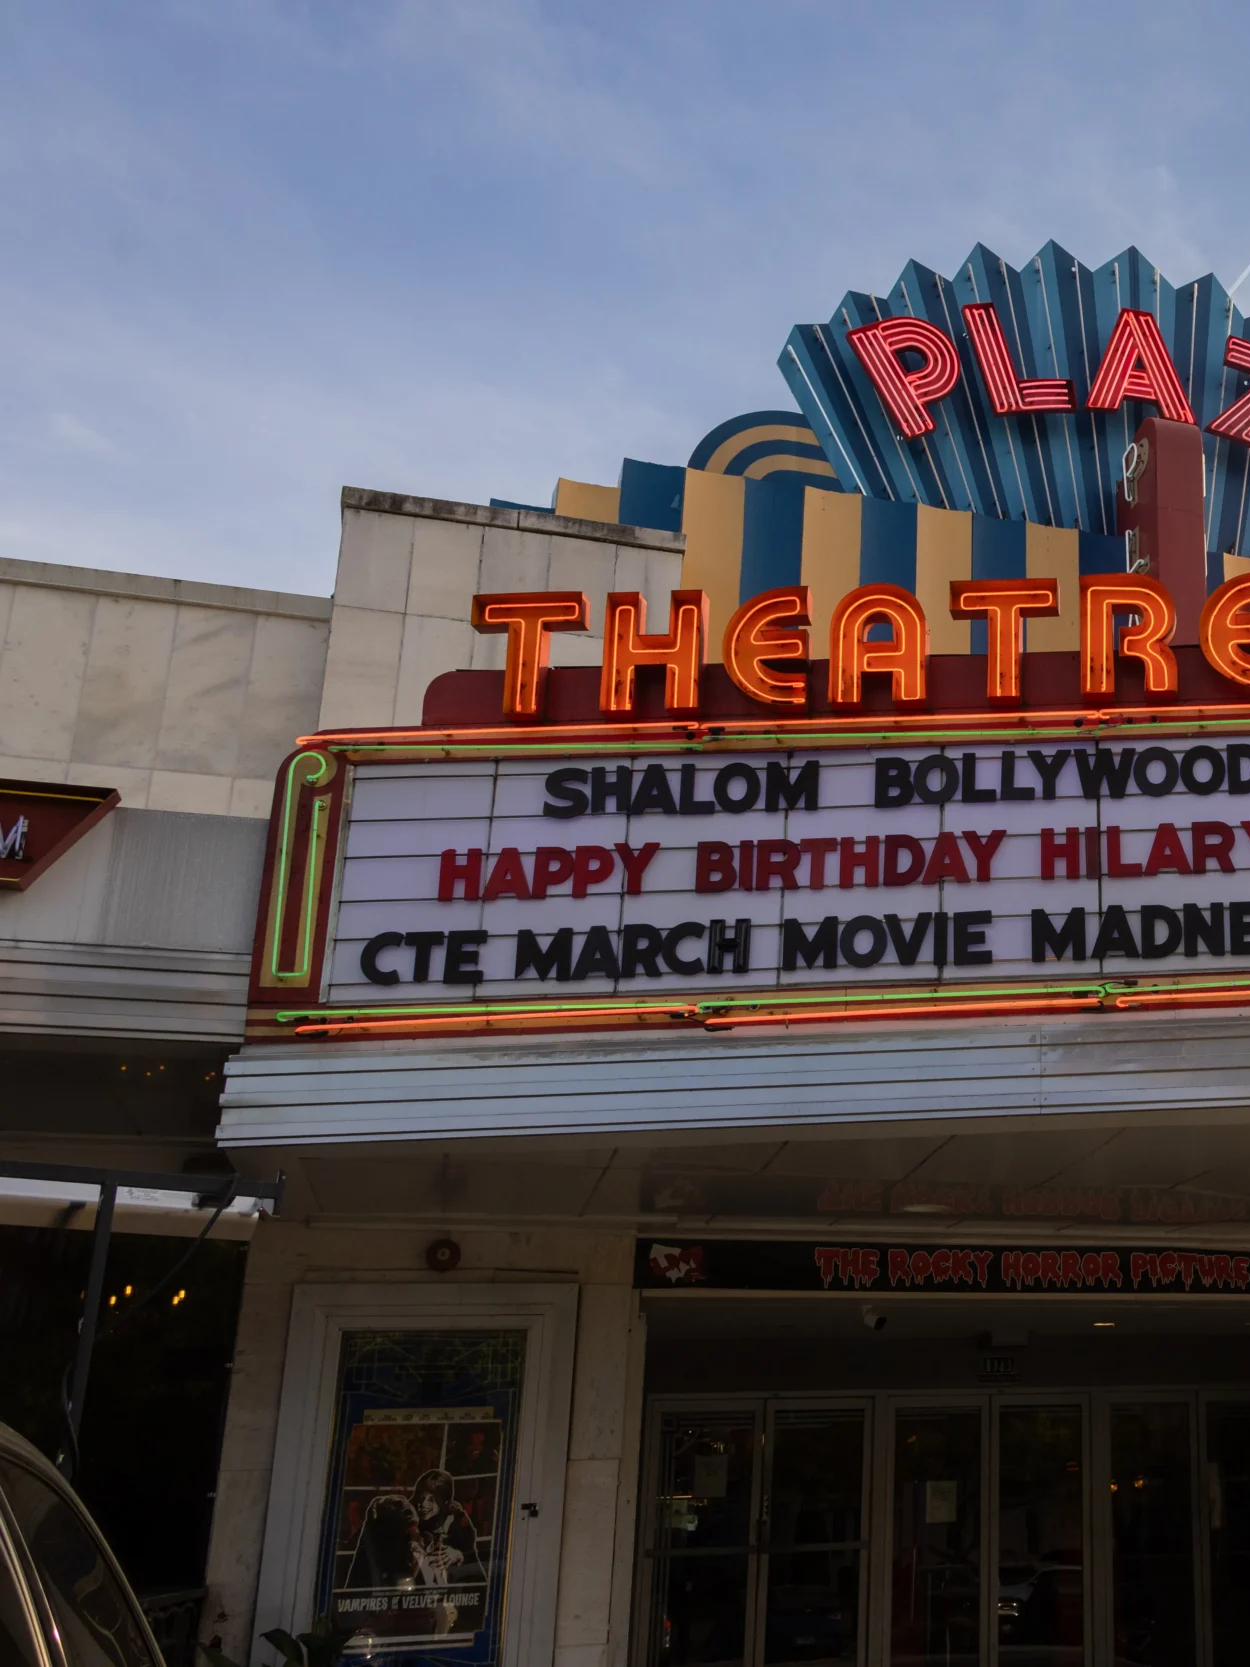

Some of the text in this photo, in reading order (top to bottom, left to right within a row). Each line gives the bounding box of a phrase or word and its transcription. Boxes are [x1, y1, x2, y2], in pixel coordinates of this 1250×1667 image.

[543, 760, 820, 819] SHALOM
[437, 842, 660, 902] HAPPY
[694, 829, 1007, 893] BIRTHDAY
[359, 930, 488, 985] CTE
[514, 918, 752, 982] MARCH
[782, 909, 992, 971] MOVIE
[815, 1247, 880, 1289] THE
[888, 1248, 993, 1289] ROCKY
[1002, 1250, 1123, 1290] HORROR
[1130, 1252, 1250, 1291] PICTURE
[338, 1596, 388, 1613] VAMPIRES
[402, 1595, 440, 1609] VELVET
[442, 1593, 481, 1607] LOUNGE
